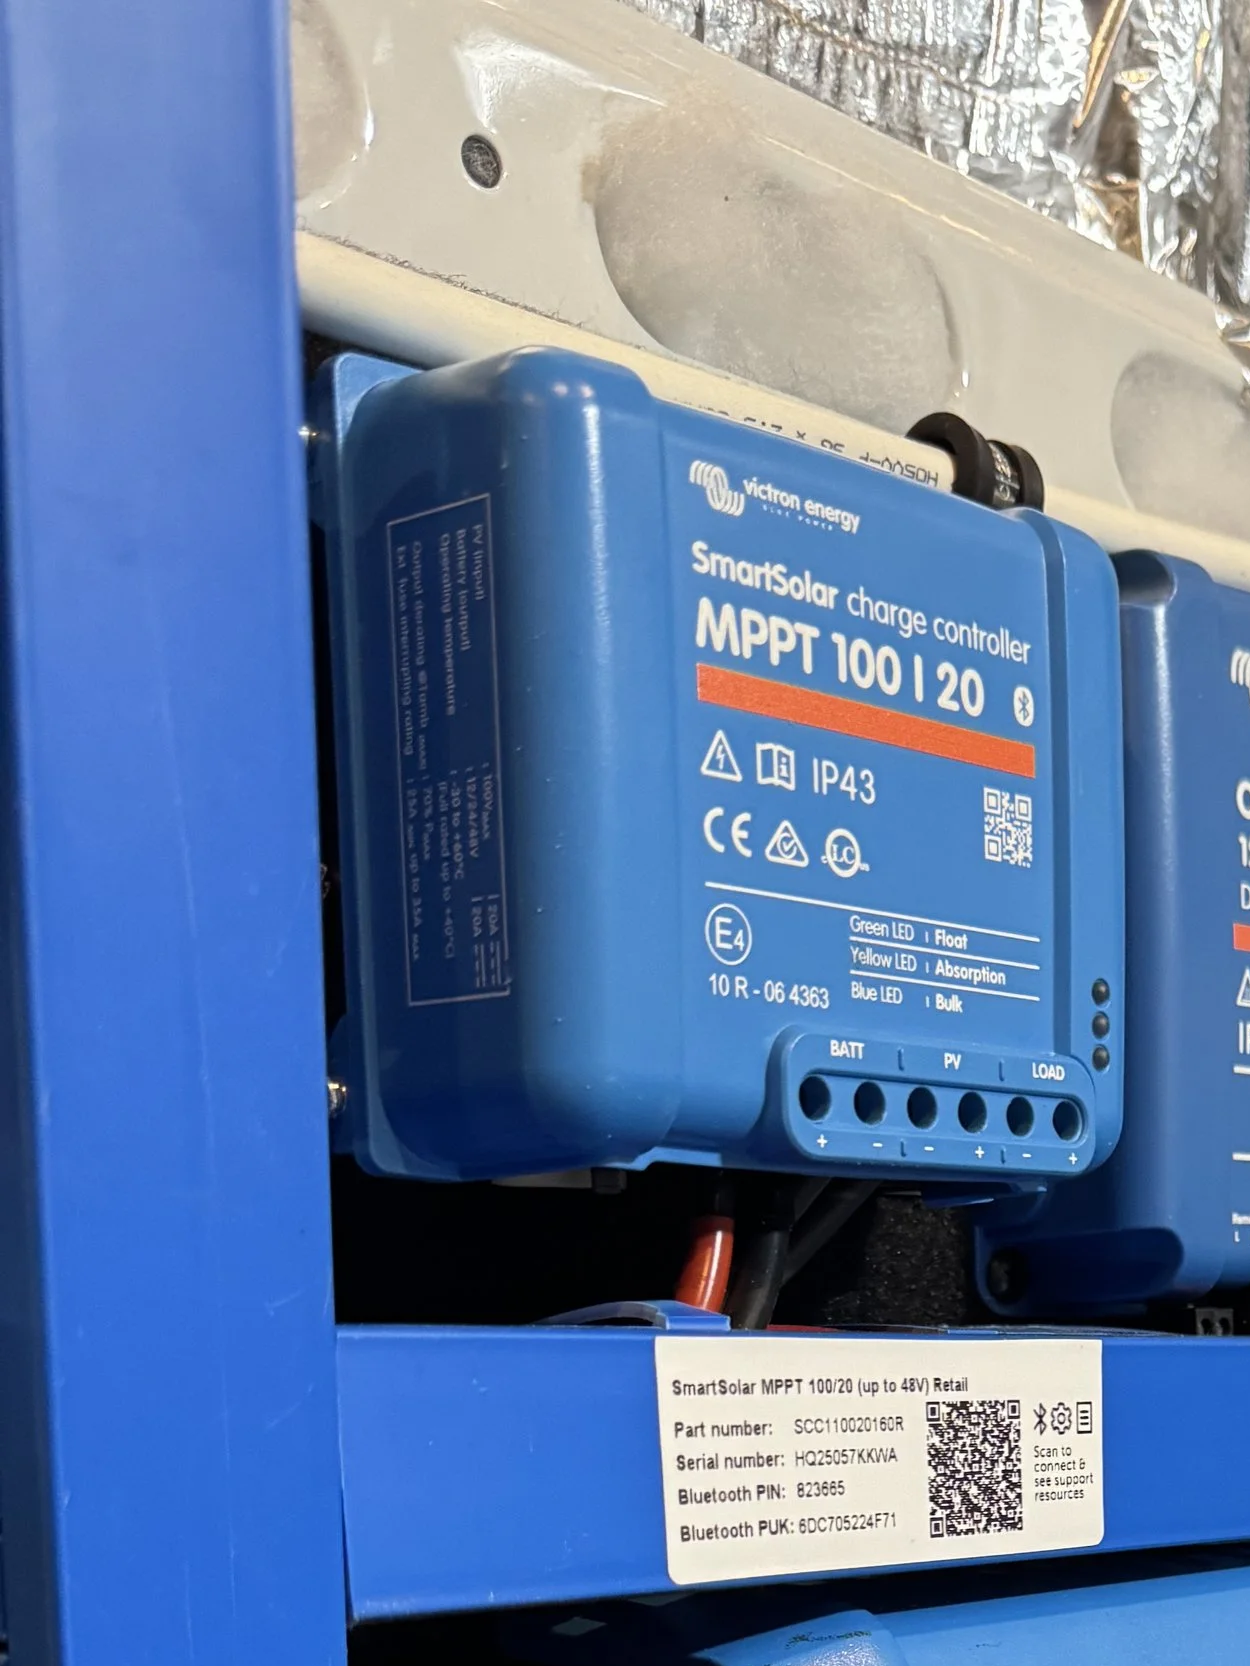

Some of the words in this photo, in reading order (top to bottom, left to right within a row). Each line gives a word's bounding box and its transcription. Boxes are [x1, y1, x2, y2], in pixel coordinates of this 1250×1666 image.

[743, 476, 801, 511] victron
[804, 499, 861, 534] energy
[472, 524, 484, 545] PV
[412, 541, 425, 596] Output
[456, 528, 469, 586] Battery
[439, 533, 452, 614] Operating
[691, 540, 839, 610] SmartSolar
[847, 586, 928, 639] charge
[933, 616, 1031, 665] controller
[444, 617, 457, 717] temperature
[695, 597, 820, 675] MPPT
[831, 631, 902, 696] 100
[936, 661, 985, 717] 20
[403, 712, 414, 756] rating
[812, 757, 876, 805] IP43
[850, 915, 890, 938] Green
[892, 921, 915, 942] LED
[934, 928, 969, 950] Float
[850, 946, 893, 969] Yellow
[895, 953, 918, 972] LED
[934, 959, 1007, 986] Absorption
[709, 973, 730, 997] 10
[735, 976, 749, 1000] R
[764, 980, 785, 1004] 06
[789, 983, 830, 1009] 4363
[851, 981, 878, 1002] Blue
[880, 986, 904, 1005] LED
[935, 992, 964, 1014] Bulk
[829, 1039, 866, 1060] BATT
[943, 1052, 962, 1071] PV
[1031, 1062, 1066, 1082] LOAD
[672, 1378, 757, 1396] SmartSolar
[761, 1378, 803, 1395] MPPT
[809, 1378, 853, 1395] 100/20
[857, 1377, 880, 1397] (up
[883, 1378, 897, 1393] to
[901, 1377, 929, 1397] 48V)
[933, 1376, 968, 1393] Retail
[674, 1421, 706, 1439] Part
[711, 1420, 773, 1437] number:
[794, 1416, 905, 1435] SCC110020160R
[676, 1453, 719, 1472] Serial
[724, 1451, 785, 1470] number:
[795, 1447, 899, 1468] HQ25057KKWA
[1033, 1445, 1059, 1458] Scan
[1061, 1446, 1072, 1457] to
[1034, 1460, 1076, 1473] connect
[678, 1485, 752, 1506] Bluetooth
[756, 1483, 786, 1501] PIN:
[796, 1479, 846, 1499] 823665
[1034, 1477, 1052, 1488] see
[1054, 1472, 1094, 1488] support
[1034, 1489, 1085, 1502] resources
[680, 1521, 754, 1543] Bluetooth
[758, 1518, 795, 1538] PUK:
[799, 1511, 897, 1535] 6DC705224F71
